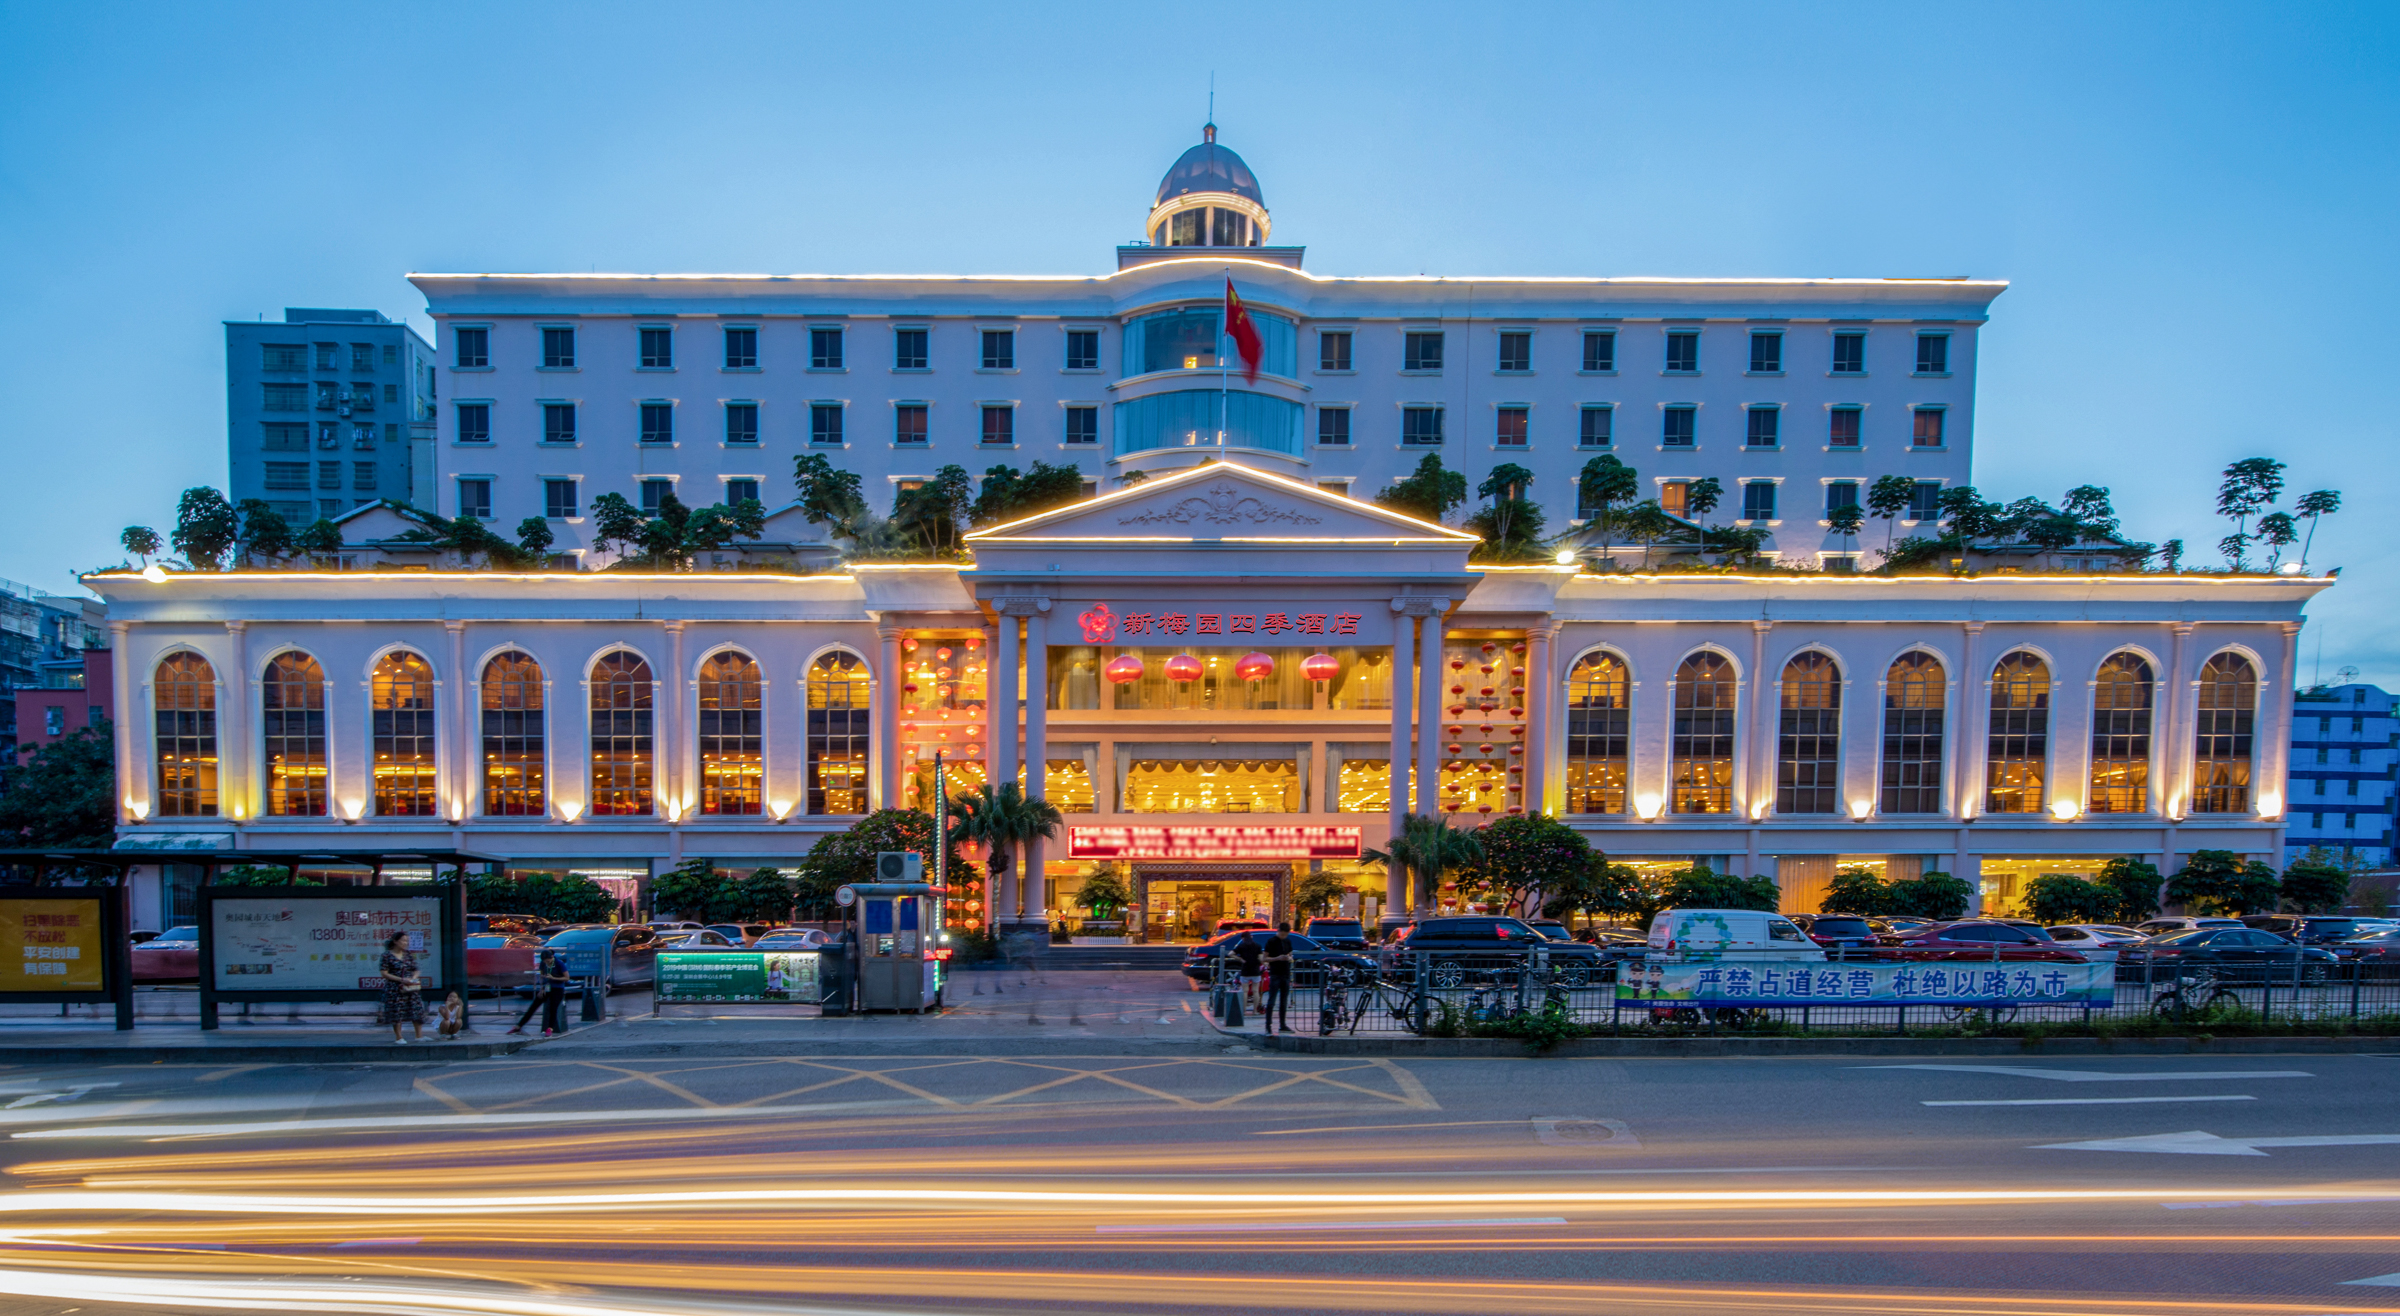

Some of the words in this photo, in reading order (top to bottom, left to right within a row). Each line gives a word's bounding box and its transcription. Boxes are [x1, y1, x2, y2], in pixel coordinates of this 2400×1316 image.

[1122, 612, 1362, 635] 新梅园四季酒店
[23, 914, 80, 927] 扫黑除恶
[225, 913, 281, 922] 奥园城市天地
[335, 910, 432, 926] 奥园城市天地
[23, 930, 66, 943] 不放松
[23, 946, 80, 959] 平安创建
[24, 962, 67, 975] 有保障
[1694, 968, 1875, 998] 严禁占道经营
[1892, 969, 2069, 998] 杜绝以路为市
